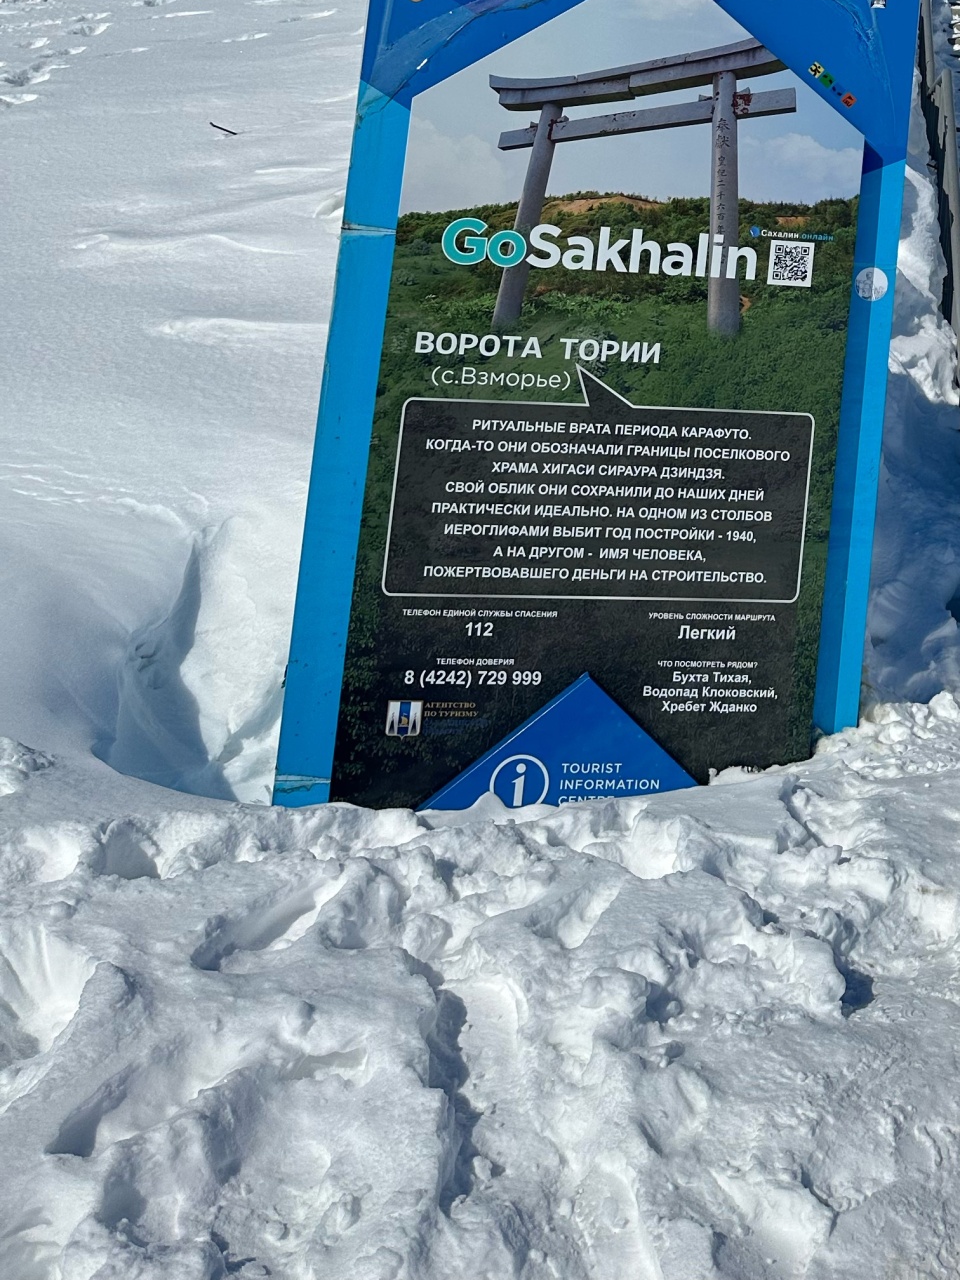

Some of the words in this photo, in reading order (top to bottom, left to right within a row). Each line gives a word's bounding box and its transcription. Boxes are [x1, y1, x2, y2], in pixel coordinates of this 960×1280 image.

[441, 217, 758, 281] GoSakhalin
[414, 331, 542, 359] ВОРОТА
[559, 338, 661, 364] ТОРИИ
[431, 365, 571, 391] (с.Взморье)
[472, 419, 567, 433] РИТУАЛЬНЫЕ
[569, 422, 612, 435] ВРАТА
[614, 424, 678, 439] ПЕРИОДА
[681, 426, 752, 440] КАРАФУТО.
[425, 438, 495, 453] КОГДА-ТО
[497, 440, 528, 453] ОНИ
[530, 441, 624, 456] ОБОЗНАЧАЛИ
[626, 444, 691, 460] ГРАНИЦЫ
[693, 447, 791, 462] ПОСЕЛКОВОГО
[491, 461, 539, 474] ХРАМА
[541, 462, 595, 476] ХИГАСИ
[598, 464, 658, 478] СИРАУРА
[659, 466, 725, 481] ДЗИНДЗЯ.
[445, 479, 485, 494] СВОЙ
[487, 482, 536, 495] ОБЛИК
[538, 483, 568, 496] ОНИ
[570, 484, 652, 498] СОХРАНИЛИ
[653, 486, 675, 500] ДО
[677, 487, 727, 500] НАШИХ
[727, 487, 765, 503] ДНЕЙ
[431, 502, 531, 516] ПРАКТИЧЕСКИ
[534, 504, 613, 518] ИДЕАЛЬНО.
[616, 506, 636, 518] НА
[638, 507, 688, 521] ОДНОМ
[690, 508, 708, 520] ИЗ
[710, 509, 773, 522] СТОЛБОВ
[443, 523, 550, 537] ИЕРОГЛИФАМИ
[552, 525, 603, 538] ВЫБИТ
[604, 526, 632, 541] ГОД
[634, 526, 715, 541] ПОСТРОЙКИ
[726, 530, 757, 544] 1940,
[492, 545, 504, 557] А
[506, 545, 527, 558] НА
[528, 546, 585, 560] ДРУГОМ
[599, 547, 629, 560] ИМЯ
[632, 548, 706, 563] ЧЕЛОВЕКА,
[423, 565, 570, 580] ПОЖЕРТВОВАВШЕГО
[571, 568, 627, 582] ДЕНЬГИ
[629, 569, 648, 581] НА
[651, 569, 767, 584] СТРОИТЕЛЬСТВО.
[402, 608, 442, 617] ТЕЛЕФОН
[442, 608, 477, 618] ЕДИНОЙ
[477, 609, 514, 618] СЛУЖБЫ
[514, 610, 558, 618] СПАСЕНИЯ
[648, 612, 685, 620] УРОВЕНЬ
[685, 612, 734, 621] СЛОЖНОСТИ
[734, 613, 776, 622] МАРШРУТА
[465, 621, 494, 637] 112
[677, 624, 736, 640] Легкий
[436, 657, 475, 666] ТЕЛЕФОН
[475, 658, 515, 667] ДОВЕРИЯ
[657, 660, 674, 668] ЧТО
[674, 660, 726, 668] ПОСМОТРЕТЬ
[727, 661, 759, 669] РЯДОМ?
[404, 669, 415, 685] 8
[419, 669, 473, 689] (4242)
[477, 670, 507, 686] 729
[512, 670, 542, 686] 999
[672, 671, 709, 685] Бухта
[712, 671, 752, 685] Тихая,
[642, 685, 699, 698] Водопад
[701, 687, 778, 700] Клоковский,
[661, 700, 706, 714] Хребет
[708, 701, 758, 714] Жданко
[561, 763, 622, 774] TOURIST
[560, 779, 660, 790] INFORMATION
